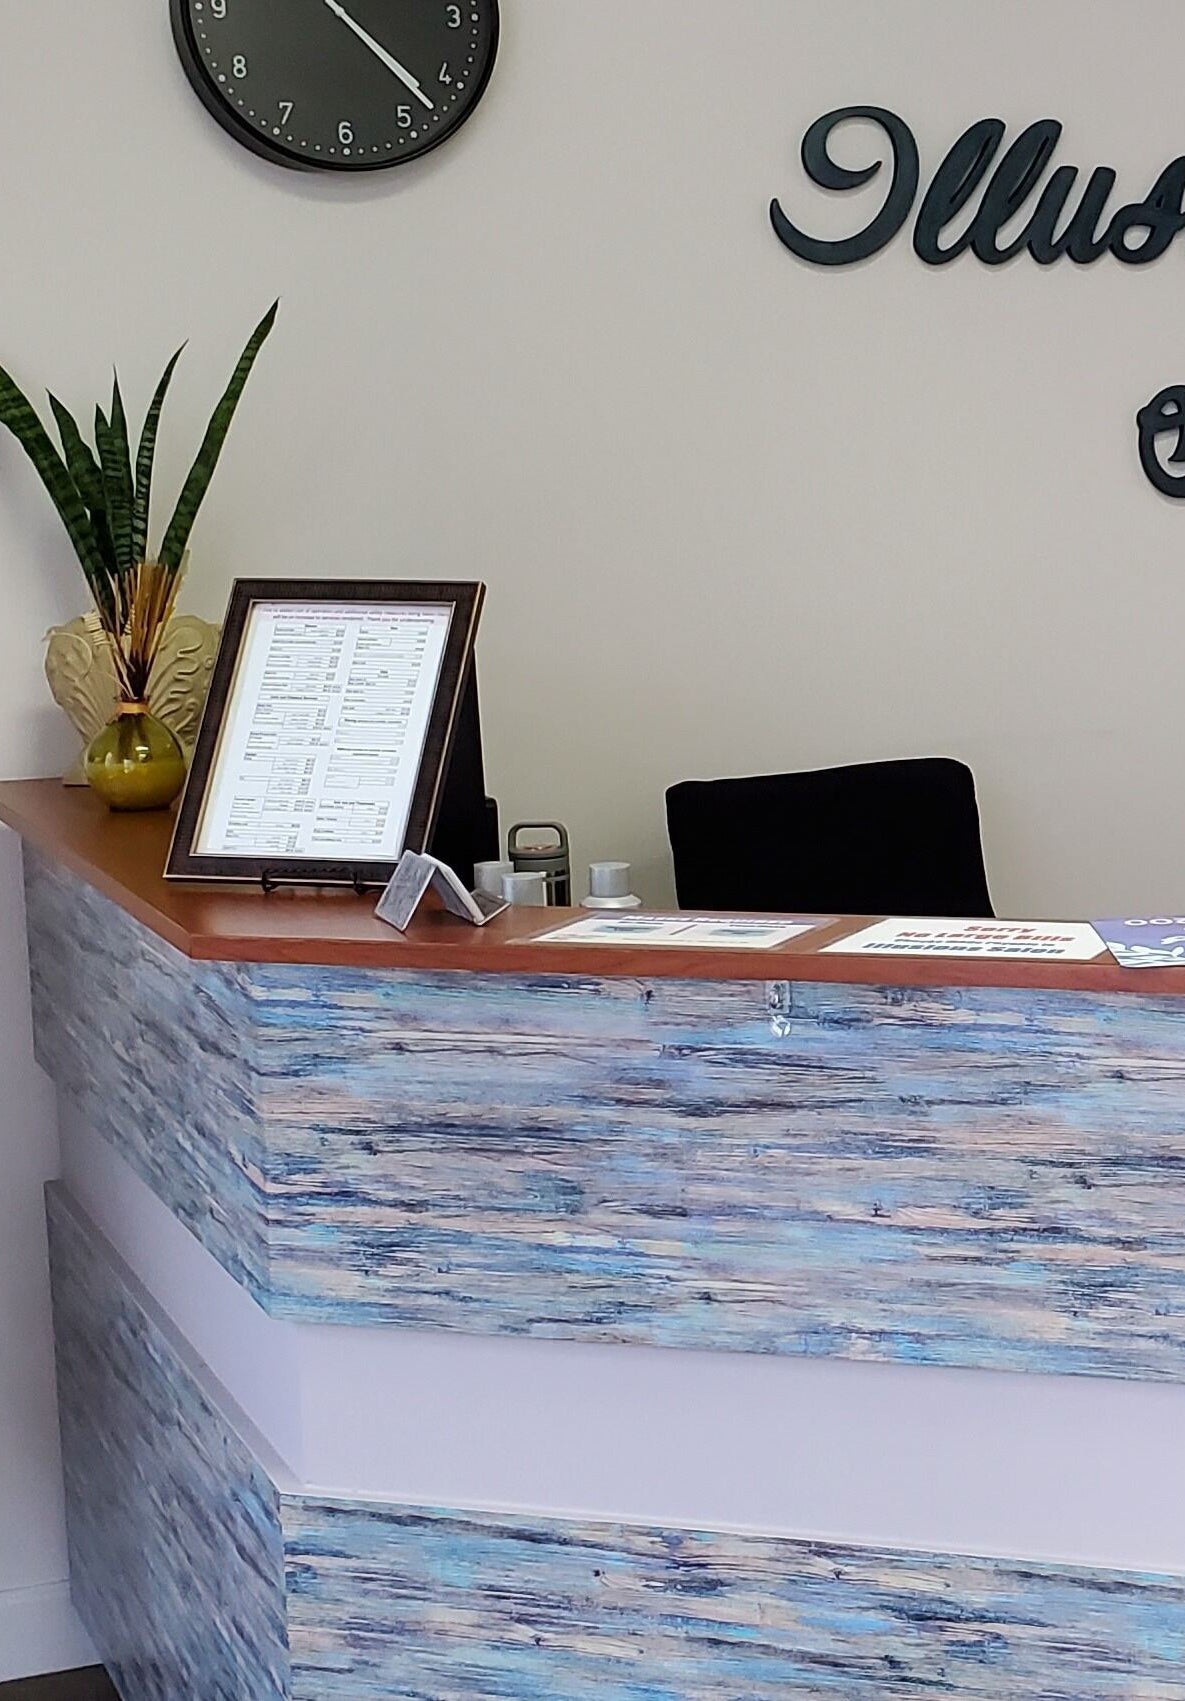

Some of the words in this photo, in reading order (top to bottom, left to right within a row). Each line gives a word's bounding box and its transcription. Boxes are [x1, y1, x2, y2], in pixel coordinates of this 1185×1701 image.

[211, 0, 227, 19] 9
[446, 5, 462, 28] 3
[232, 55, 247, 78] 8
[438, 62, 452, 85] 4
[278, 102, 293, 125] 7
[396, 105, 411, 128] 5
[338, 121, 353, 145] 6
[934, 932, 1010, 940] Large
[963, 925, 1037, 933] Sorry
[862, 942, 984, 952] Illusions
[987, 946, 1066, 955] Salon
